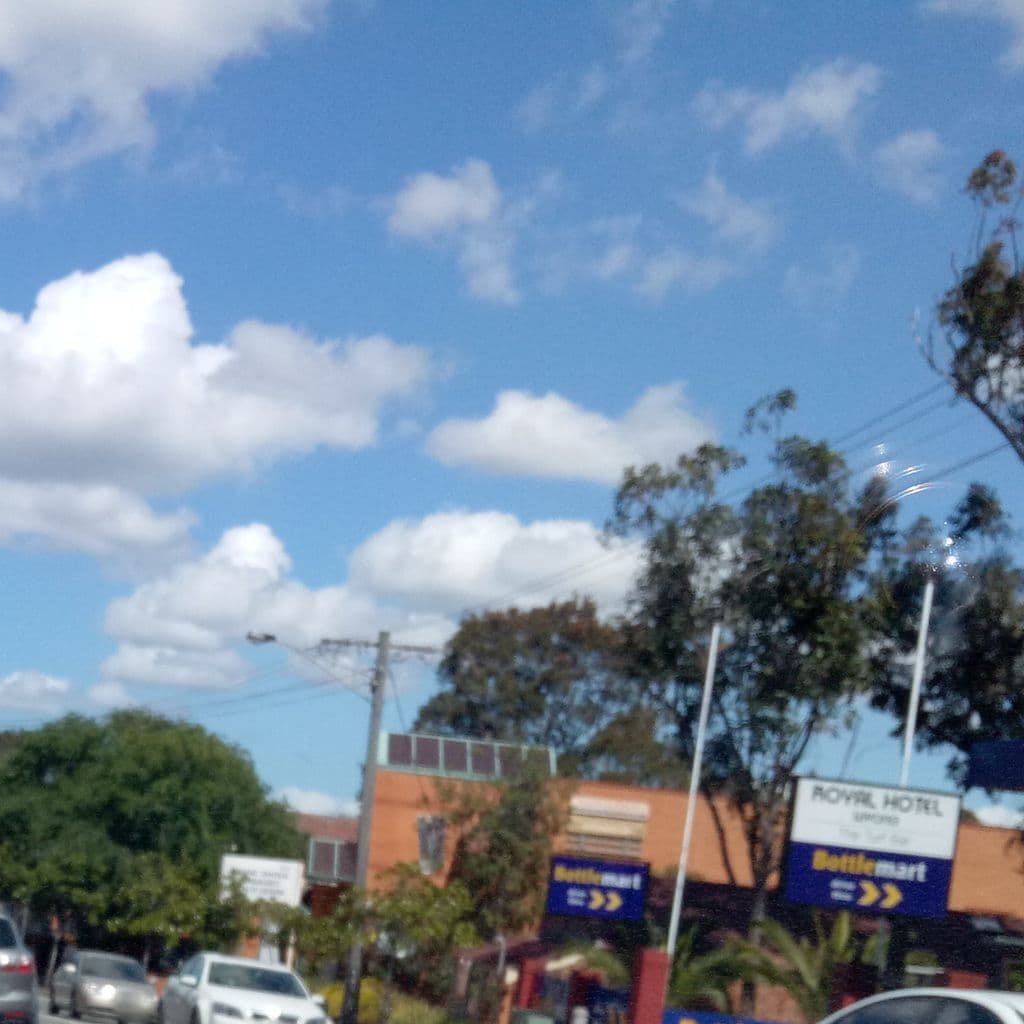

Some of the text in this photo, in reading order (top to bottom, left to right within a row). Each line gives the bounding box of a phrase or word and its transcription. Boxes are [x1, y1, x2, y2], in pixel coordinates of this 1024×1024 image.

[883, 793, 943, 818] HOTEL
[553, 864, 643, 891] Bottlemart
[812, 848, 928, 883] Bottlemart
